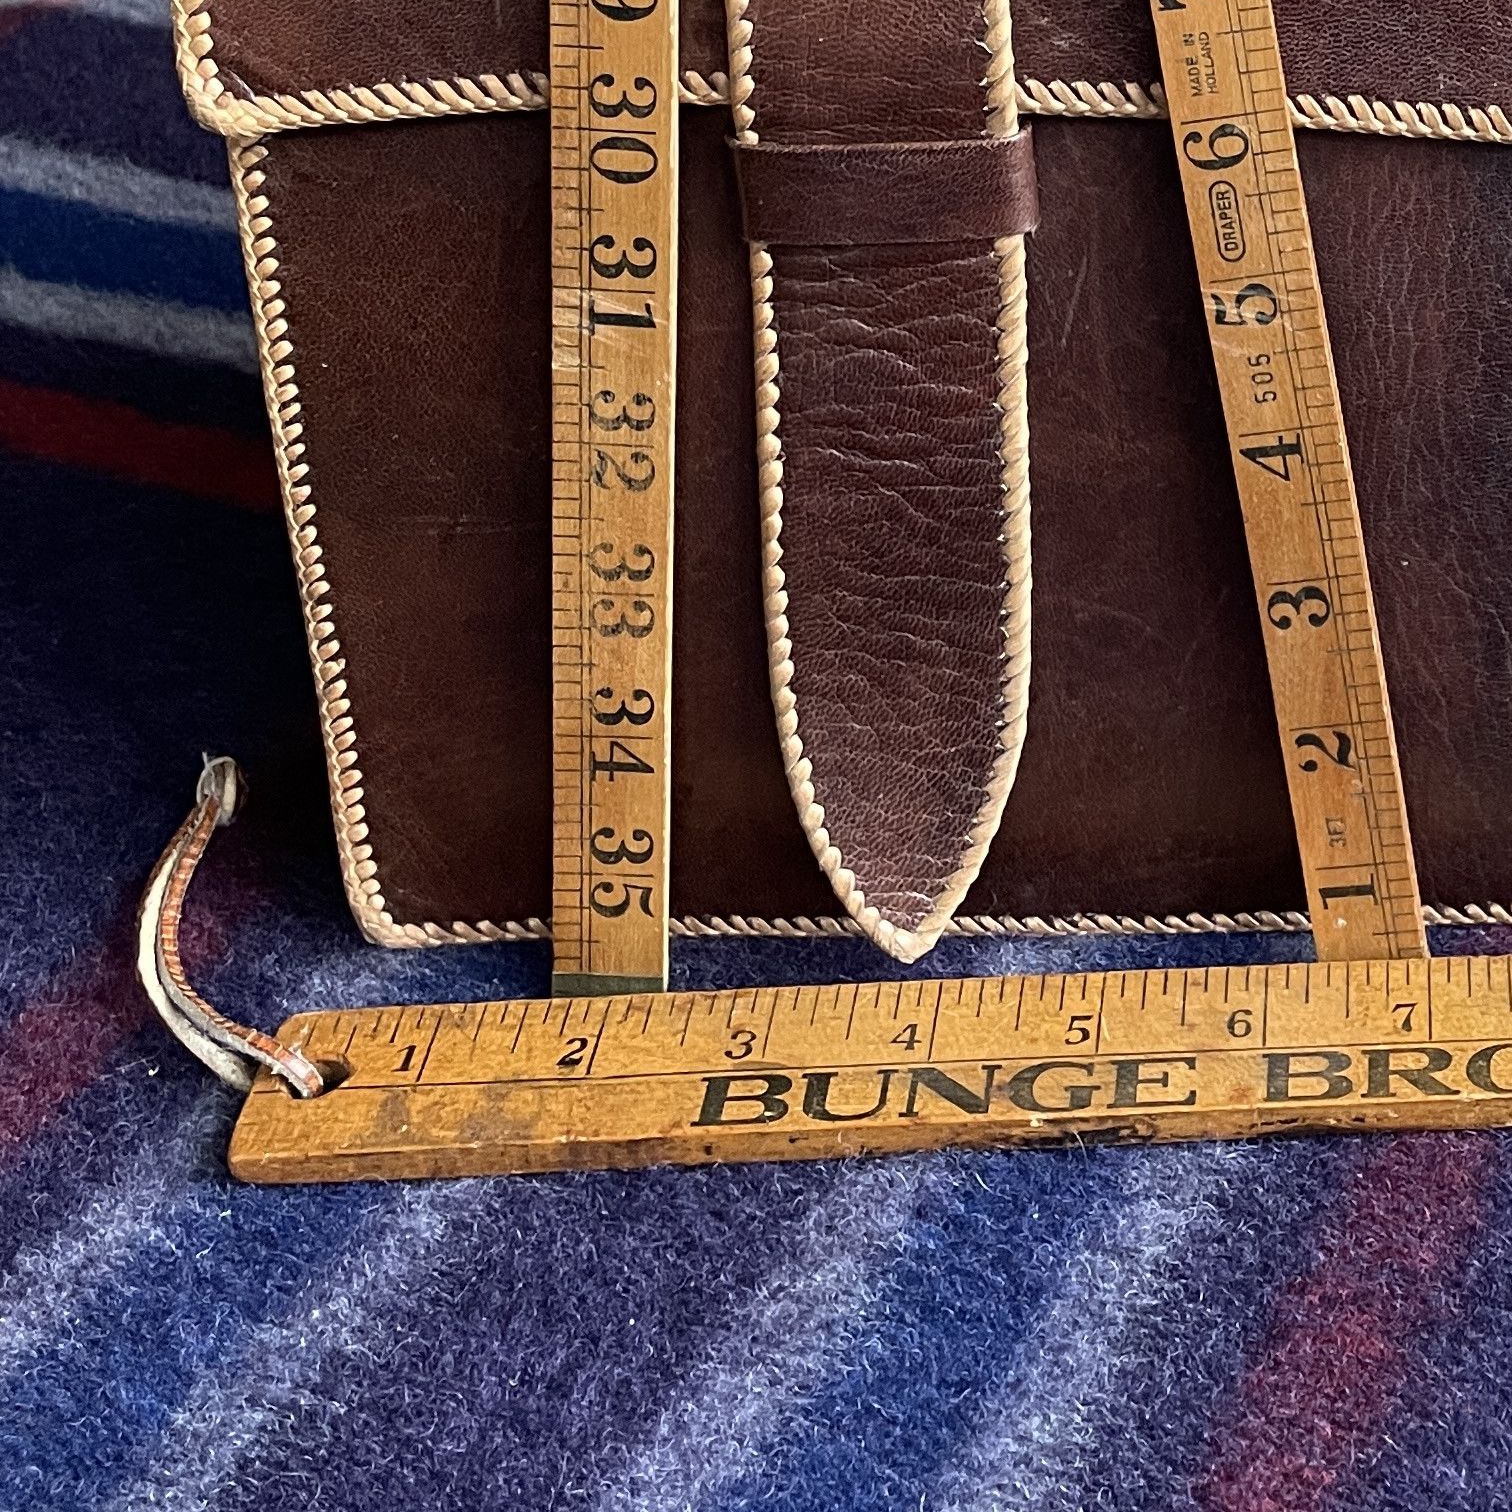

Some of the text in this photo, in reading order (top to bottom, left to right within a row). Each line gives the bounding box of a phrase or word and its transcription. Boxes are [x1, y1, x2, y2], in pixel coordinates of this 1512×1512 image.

[1183, 32, 1202, 97] MADE IN
[1198, 31, 1219, 95] HOLLAND
[590, 72, 658, 185] 30
[1183, 123, 1250, 171] 6
[1217, 190, 1240, 252] DRAPER
[589, 234, 658, 338] 31
[1210, 283, 1278, 327] 5
[1247, 351, 1277, 405] 505
[589, 390, 657, 494] 32
[1239, 432, 1306, 482] 4
[589, 542, 657, 639] 33
[1268, 584, 1331, 630] 3
[590, 686, 656, 783] 34
[1295, 730, 1357, 772] 2
[590, 826, 656, 920] 35
[1319, 873, 1379, 910] 1
[891, 1023, 922, 1051] 4
[1064, 1015, 1093, 1046] 5
[1226, 1009, 1253, 1038] 6
[1392, 1003, 1417, 1034] 7
[392, 1045, 418, 1073] 1
[556, 1037, 590, 1068] 2
[724, 1030, 758, 1060] 3
[690, 1056, 1198, 1128] BUNGE
